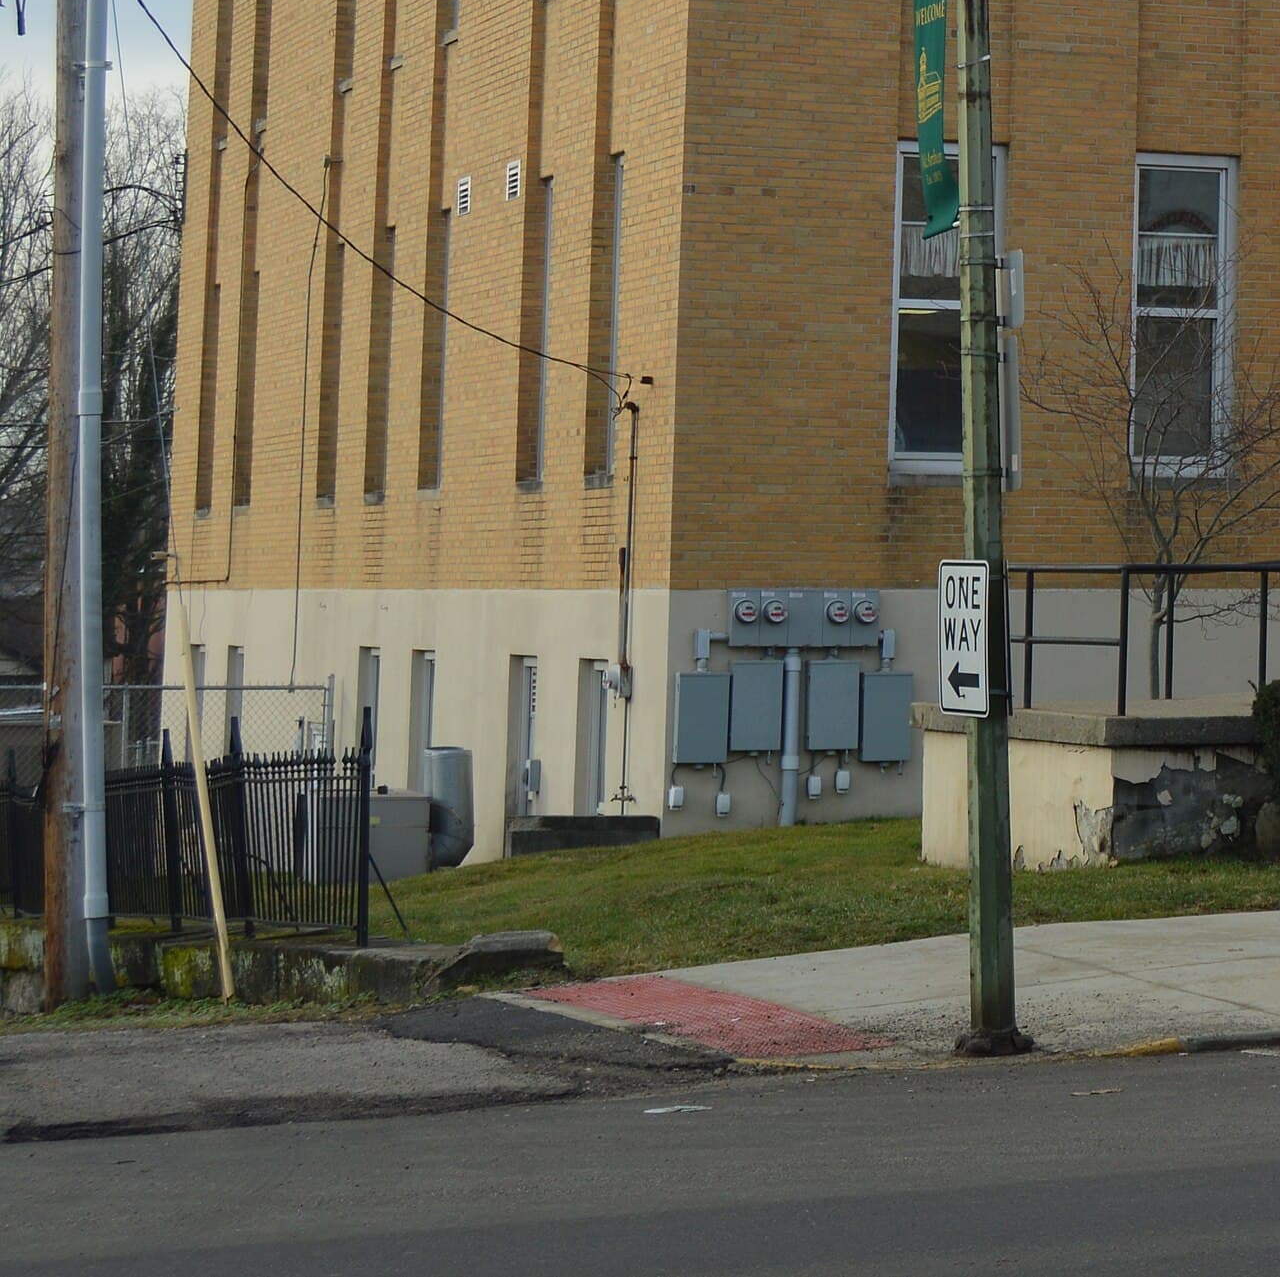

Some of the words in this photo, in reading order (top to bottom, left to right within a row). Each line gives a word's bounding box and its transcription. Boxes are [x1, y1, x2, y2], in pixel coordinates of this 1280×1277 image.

[915, 0, 945, 27] WELCOME
[945, 575, 981, 609] ONE
[944, 617, 981, 652] WAY
